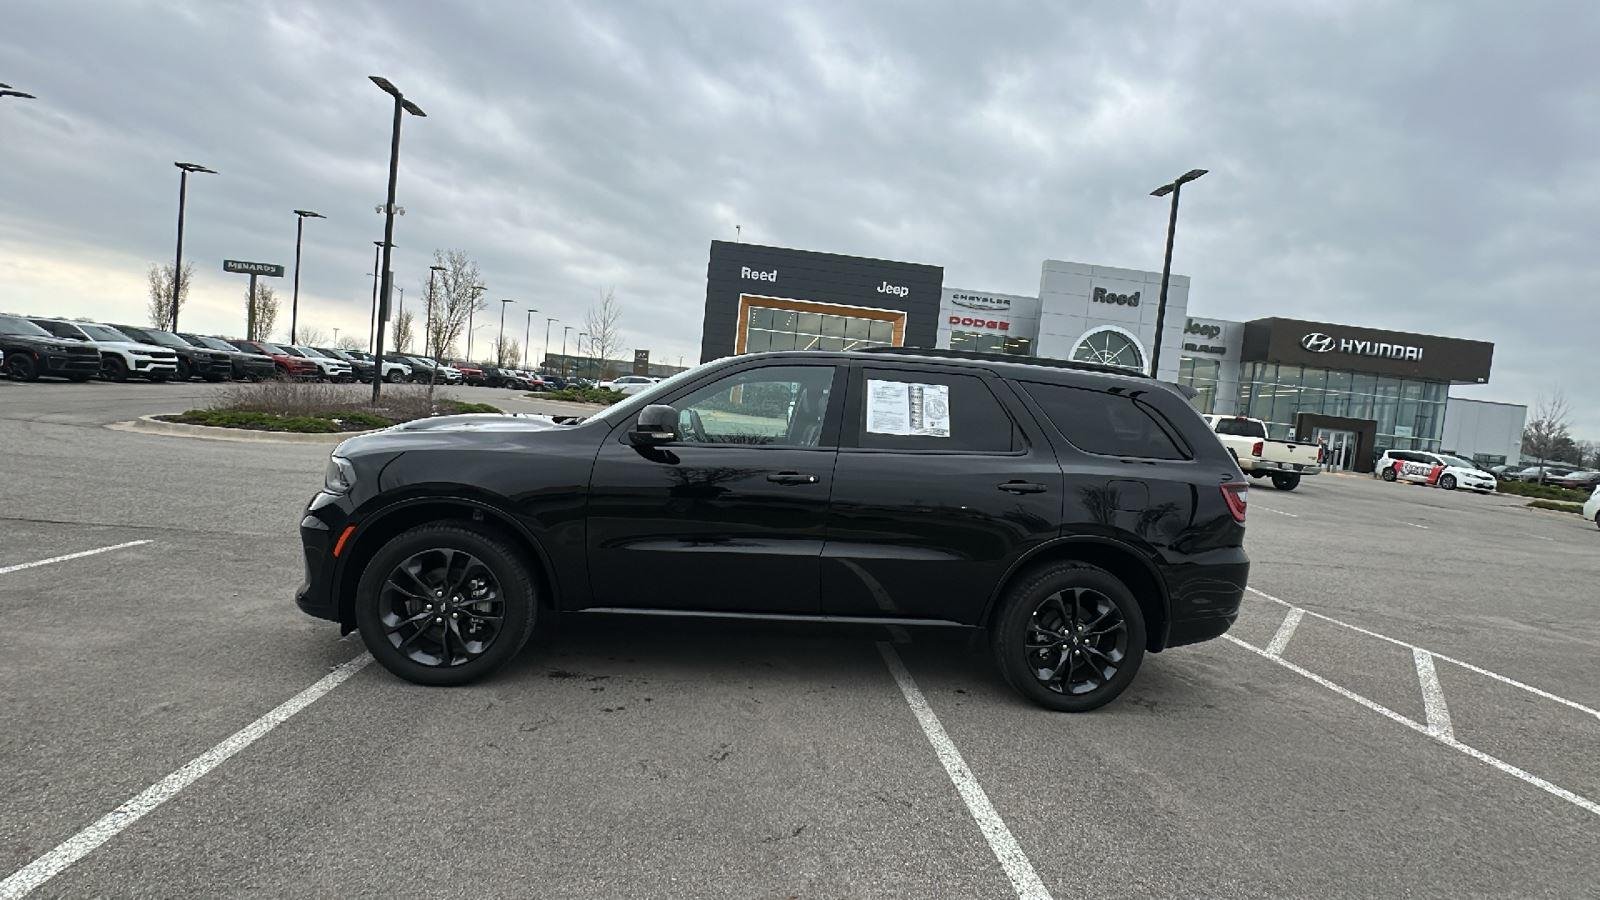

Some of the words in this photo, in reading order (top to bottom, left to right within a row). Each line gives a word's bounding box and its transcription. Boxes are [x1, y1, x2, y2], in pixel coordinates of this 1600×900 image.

[227, 261, 276, 273] MENARDS
[741, 266, 778, 283] Reed
[876, 281, 909, 298] Jeep
[1093, 286, 1141, 307] Reed
[949, 316, 1010, 331] DODGE
[1183, 318, 1221, 339] Jeep
[1340, 338, 1424, 361] HYUNDAI
